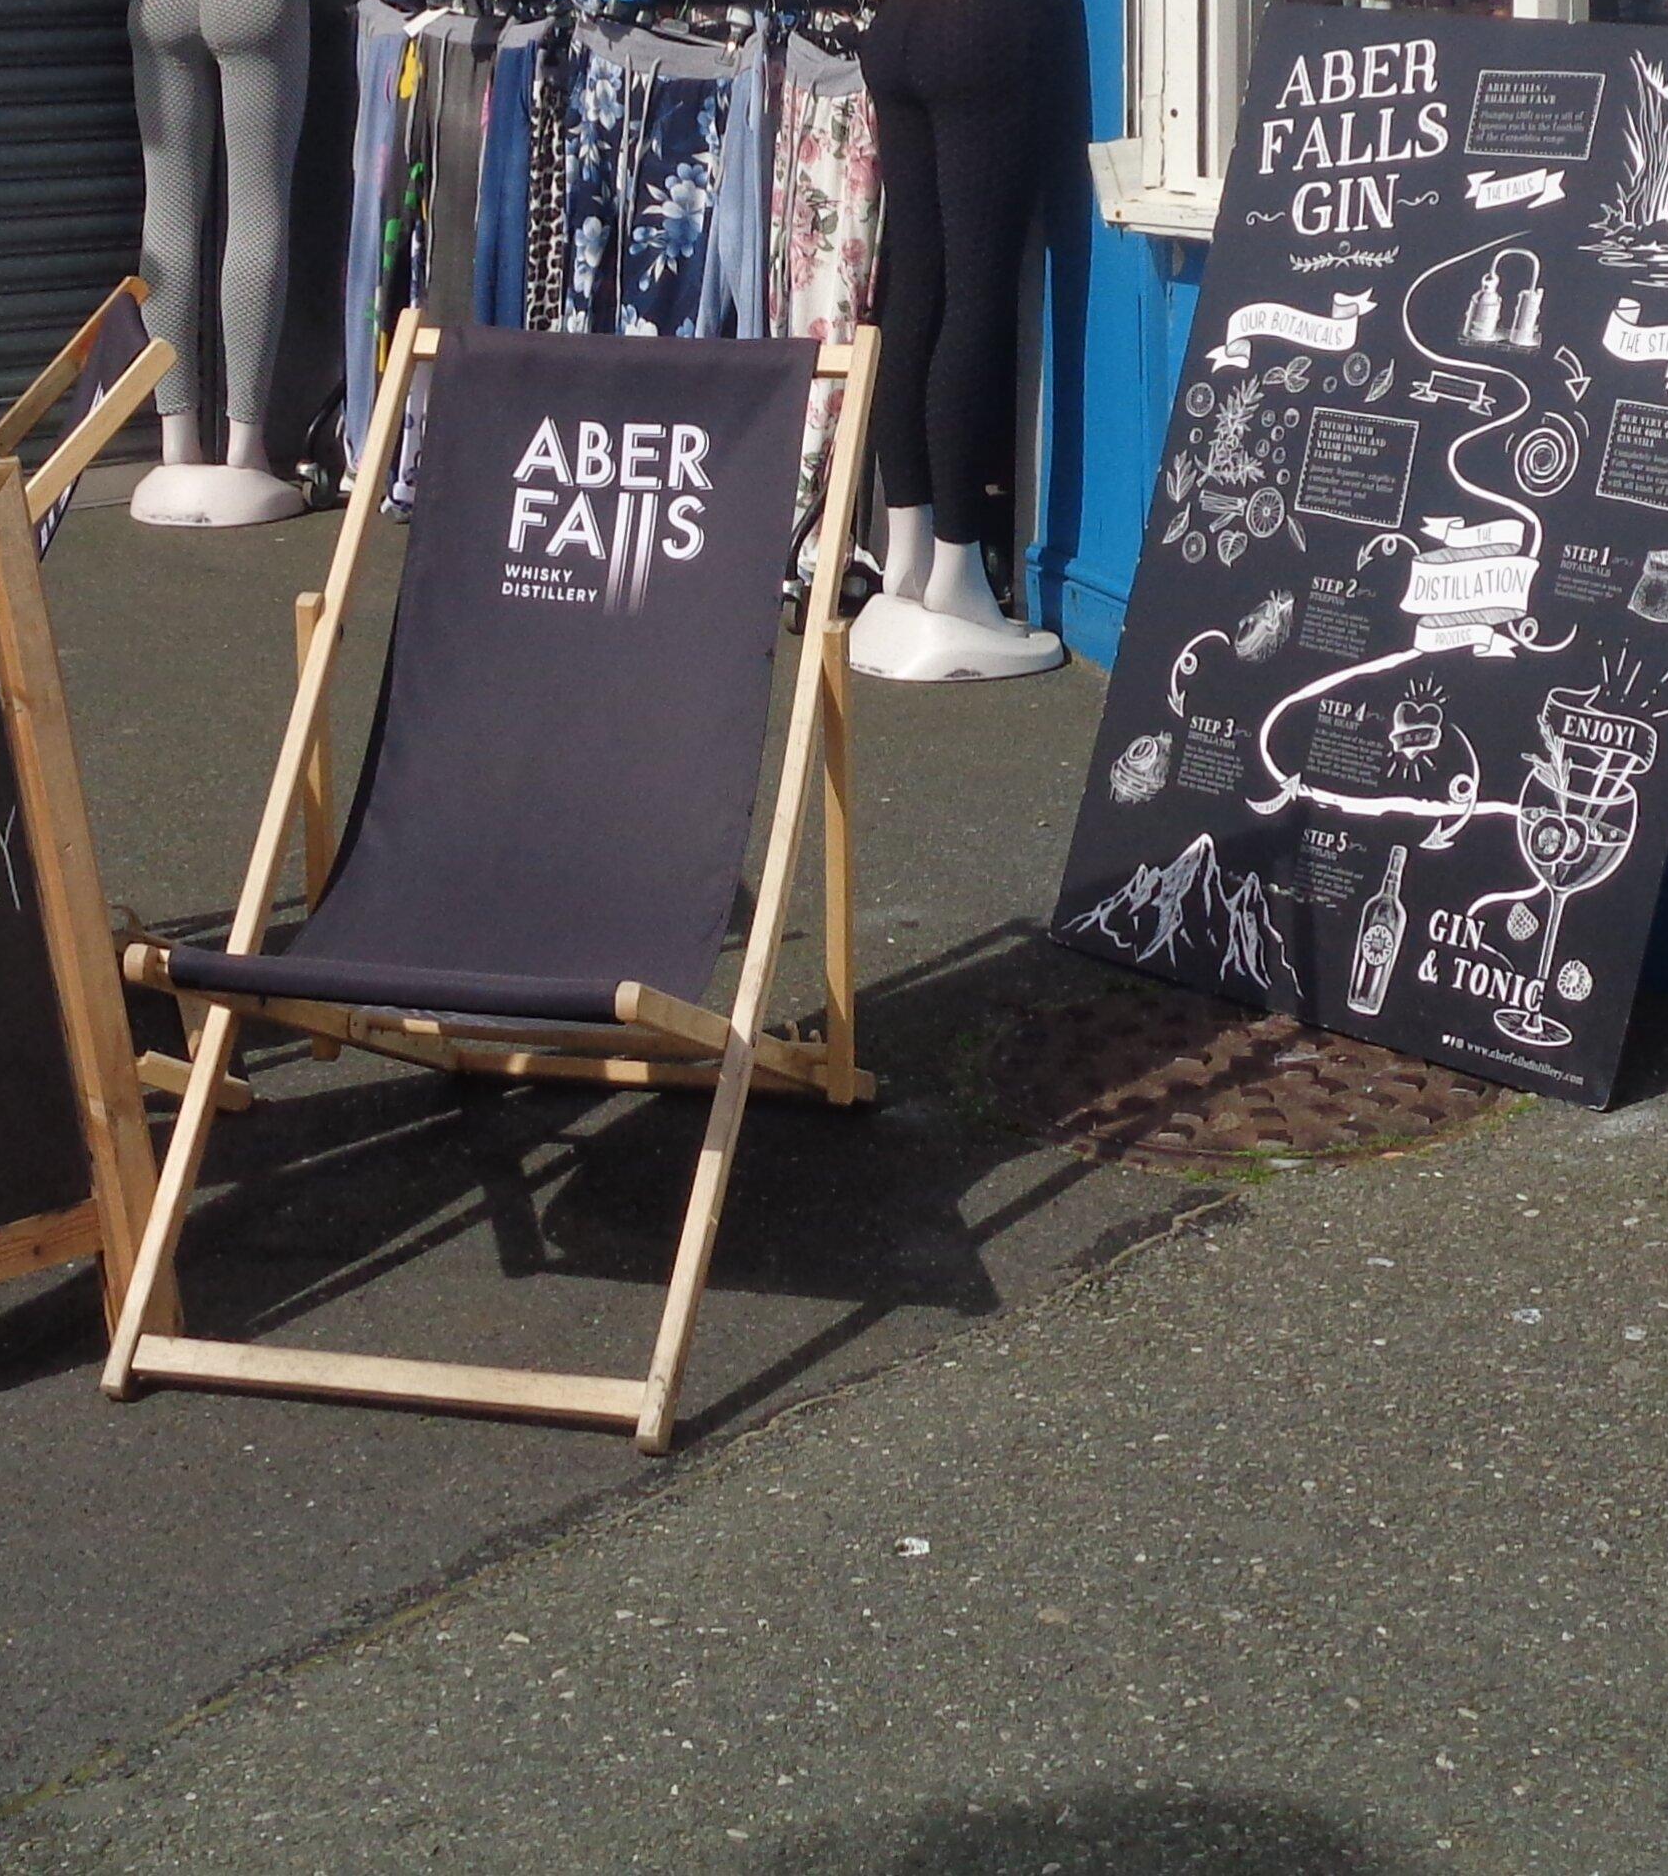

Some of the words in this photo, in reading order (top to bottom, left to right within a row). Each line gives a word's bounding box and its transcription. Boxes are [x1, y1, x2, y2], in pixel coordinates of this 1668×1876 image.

[1276, 38, 1437, 111] ABER
[1258, 101, 1449, 174] FALLS
[1507, 177, 1535, 197] FALLS
[1291, 174, 1400, 237] GIN
[1239, 311, 1267, 332] OUR
[1270, 312, 1343, 347] BOTANICALS
[1619, 331, 1642, 353] THE
[512, 415, 714, 491] ABER
[1476, 527, 1493, 543] THE
[507, 487, 707, 616] FALLS
[1563, 544, 1598, 563] STEP
[1601, 546, 1611, 566] 1
[504, 563, 573, 583] WHISKY
[1312, 576, 1344, 594] STEP
[1346, 578, 1358, 598] 2
[1413, 567, 1529, 602] DISTILLATION
[501, 581, 598, 603] DISTILLERY
[1319, 698, 1352, 717] STEP
[1355, 701, 1367, 721] 4
[1189, 716, 1222, 734] STEP
[1224, 718, 1234, 738] 3
[1562, 714, 1635, 750] ENJOY!
[1302, 828, 1336, 848] STEP
[1337, 830, 1350, 852] 5
[1429, 908, 1487, 953] GIN
[1417, 949, 1439, 984] &
[1454, 959, 1547, 1013] TONIC
